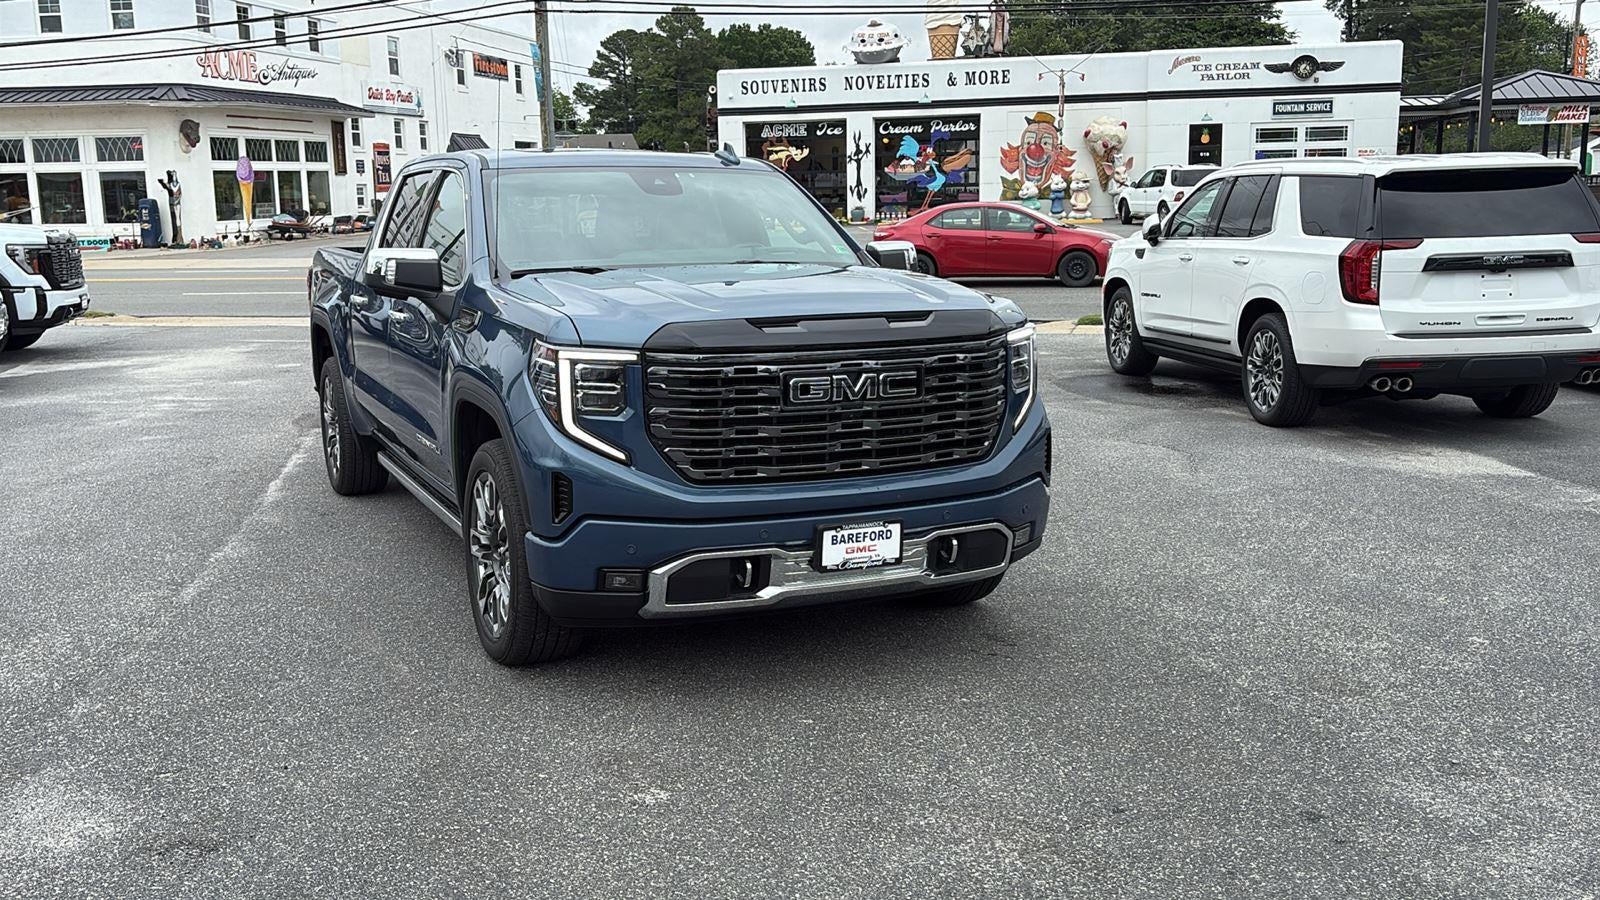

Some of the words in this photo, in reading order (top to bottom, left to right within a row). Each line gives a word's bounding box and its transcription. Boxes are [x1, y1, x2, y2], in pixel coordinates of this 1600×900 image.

[1577, 38, 1586, 73] ACME
[196, 46, 259, 83] ACME
[271, 58, 318, 87] Antiques
[1192, 63, 1212, 72] ICE
[1215, 62, 1260, 71] CREAM
[741, 77, 827, 95] SOUVENIRS
[844, 73, 930, 91] NOVELTIES
[947, 72, 957, 87] &
[965, 69, 1011, 86] MORE
[1200, 73, 1251, 81] PARLOR
[368, 87, 383, 100] Dutch
[386, 89, 396, 104] Boy
[396, 90, 413, 103] Paints
[1275, 101, 1305, 113] FOUNTAIN
[1306, 100, 1331, 112] SERVICE
[1562, 104, 1589, 113] MILK
[1554, 113, 1588, 121] SHAKES
[761, 124, 808, 138] ACME
[816, 122, 844, 136] Ice
[879, 121, 924, 135] Cream
[930, 120, 978, 133] Parlor
[377, 170, 390, 183] TEA
[790, 372, 917, 403] GMC
[842, 521, 884, 530] TAPPAHANNOCK
[831, 529, 893, 546] BAREFORD
[845, 544, 877, 554] GMC
